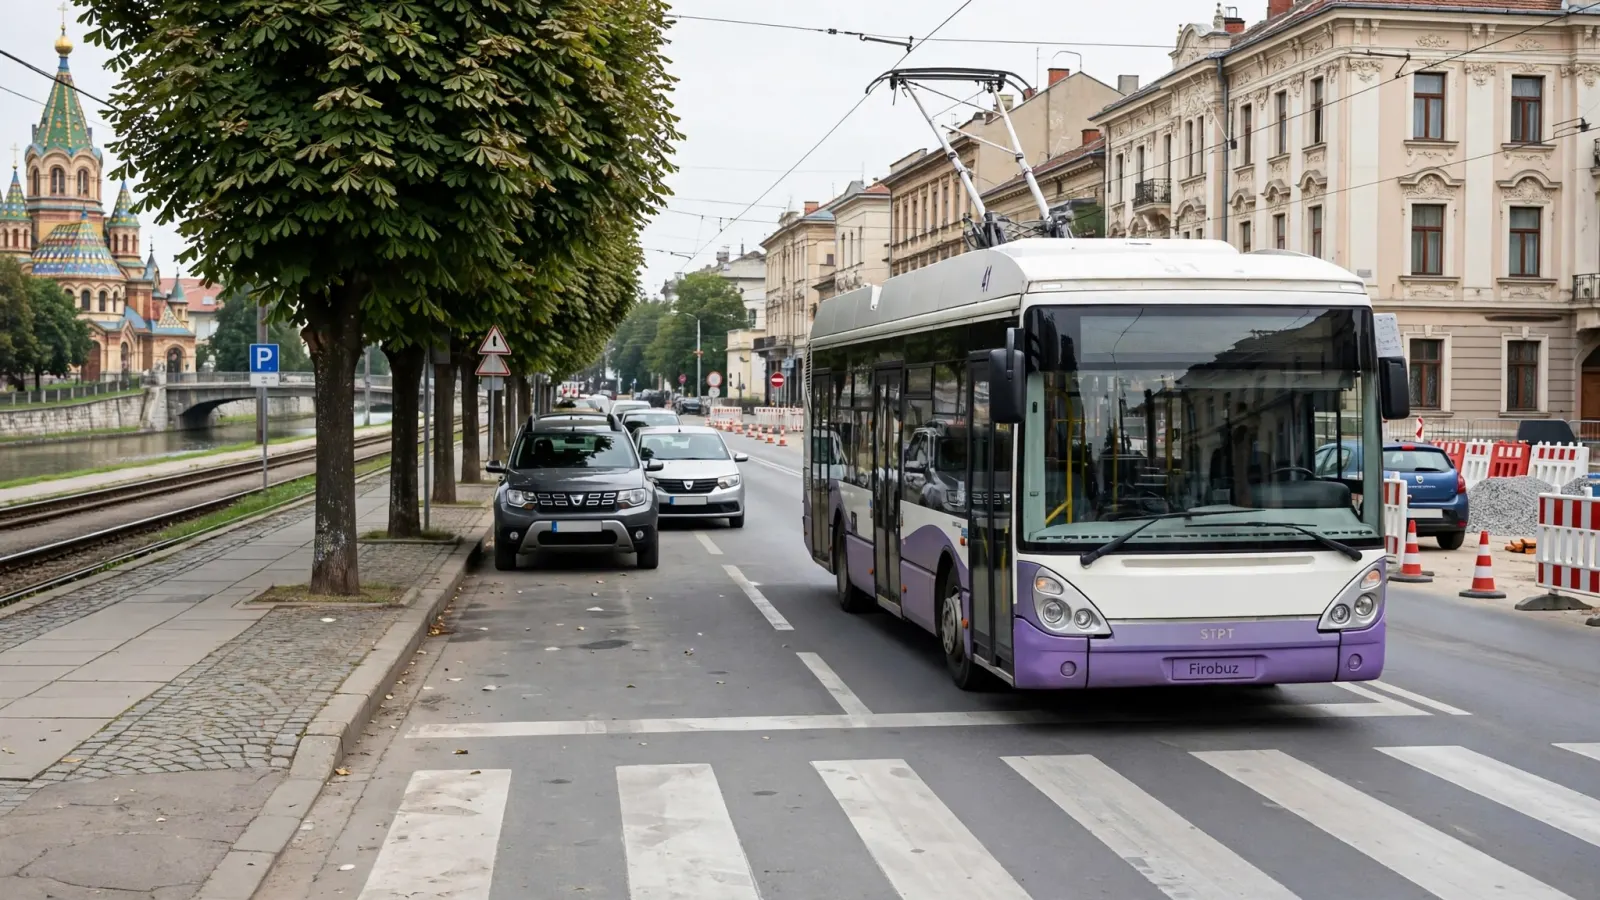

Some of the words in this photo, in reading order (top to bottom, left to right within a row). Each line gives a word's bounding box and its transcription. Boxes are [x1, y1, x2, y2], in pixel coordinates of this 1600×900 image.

[257, 347, 272, 369] P
[1200, 628, 1235, 640] STPT
[1189, 662, 1239, 675] Firobuz
